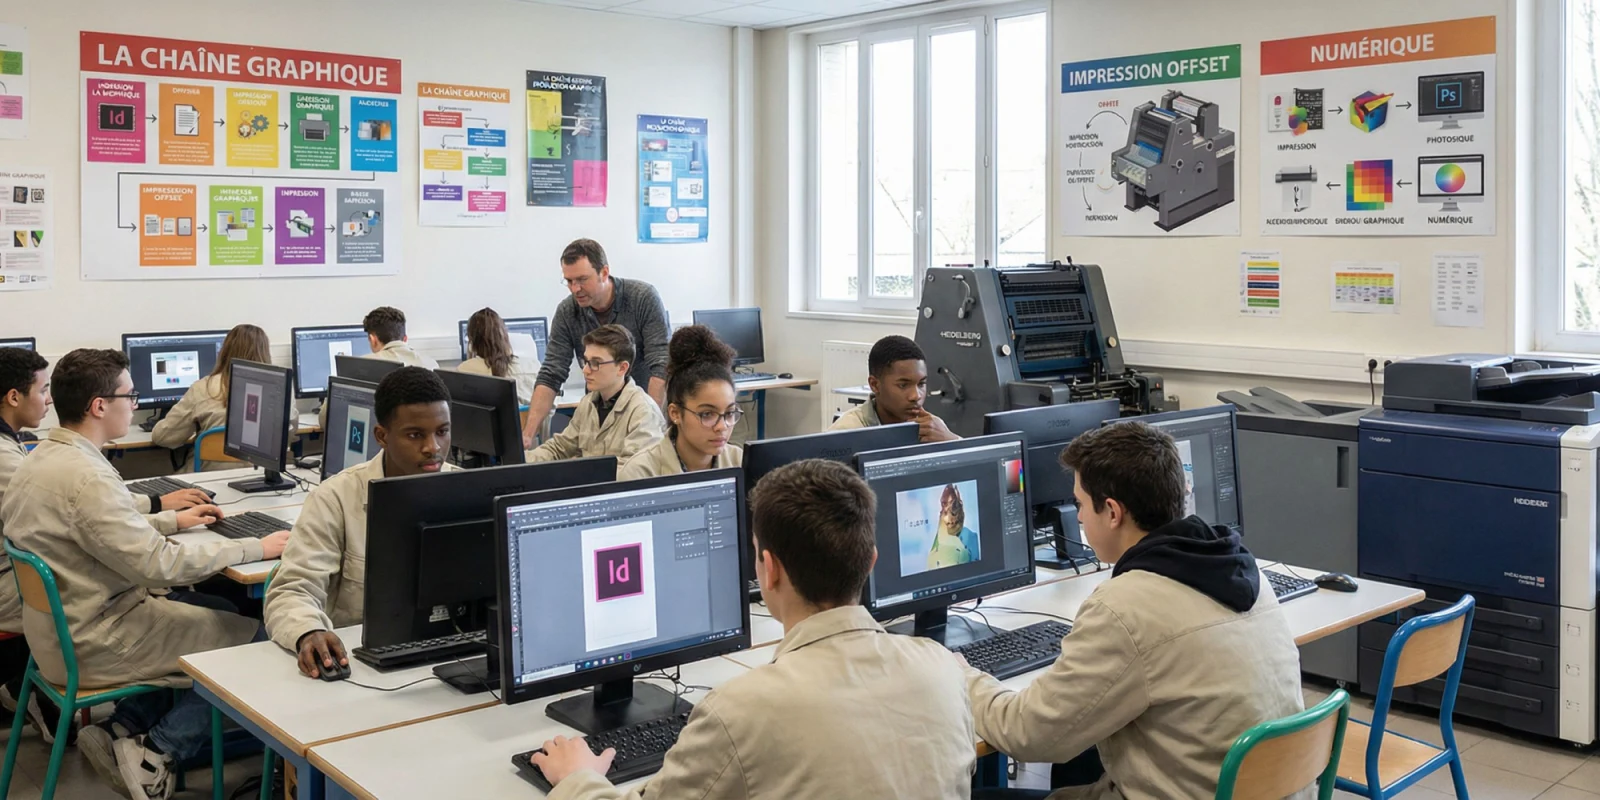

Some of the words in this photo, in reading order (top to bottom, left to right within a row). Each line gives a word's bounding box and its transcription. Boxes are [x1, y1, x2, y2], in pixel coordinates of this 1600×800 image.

[1311, 33, 1435, 63] NUMÉRIQUE
[98, 43, 133, 67] LA
[140, 47, 241, 75] CHAÎNE
[247, 55, 389, 87] GRAPHIQUE
[1070, 63, 1162, 86] IMPRESSION
[1167, 55, 1230, 76] OFFSET
[422, 86, 433, 94] LA
[1441, 88, 1457, 102] Ps
[109, 109, 125, 125] Id
[1363, 217, 1405, 226] GRAPHIQUE
[351, 425, 361, 445] Ps
[608, 557, 630, 585] Id
